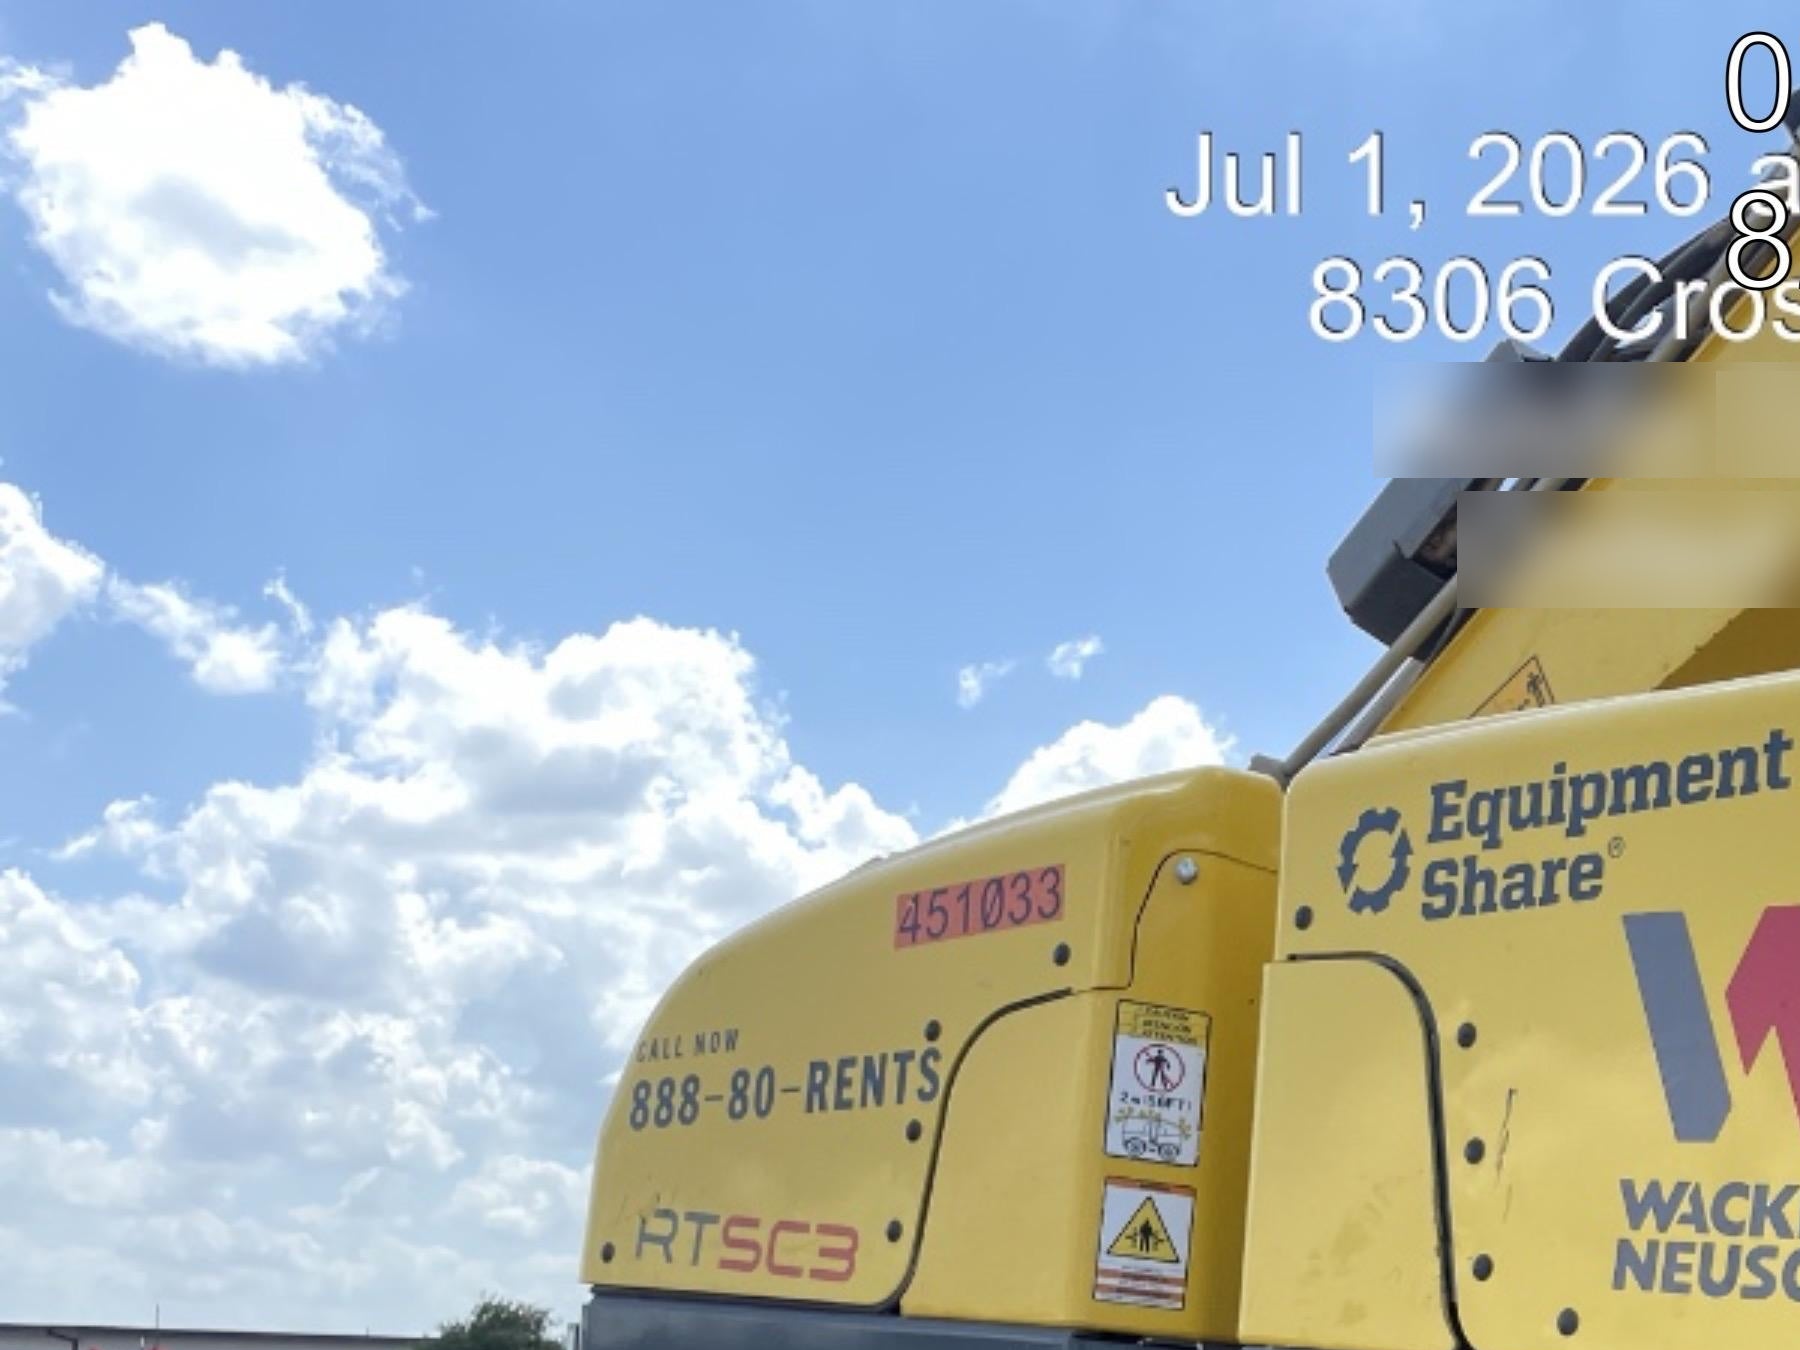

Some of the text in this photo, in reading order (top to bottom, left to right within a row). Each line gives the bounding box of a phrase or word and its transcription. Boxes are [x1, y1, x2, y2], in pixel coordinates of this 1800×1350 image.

[1427, 728, 1794, 850] Equipment
[900, 866, 1062, 944] 451033
[695, 1028, 740, 1055] NOW
[629, 1047, 942, 1132] 888-80-RENTS
[635, 1207, 860, 1282] RTSC3
